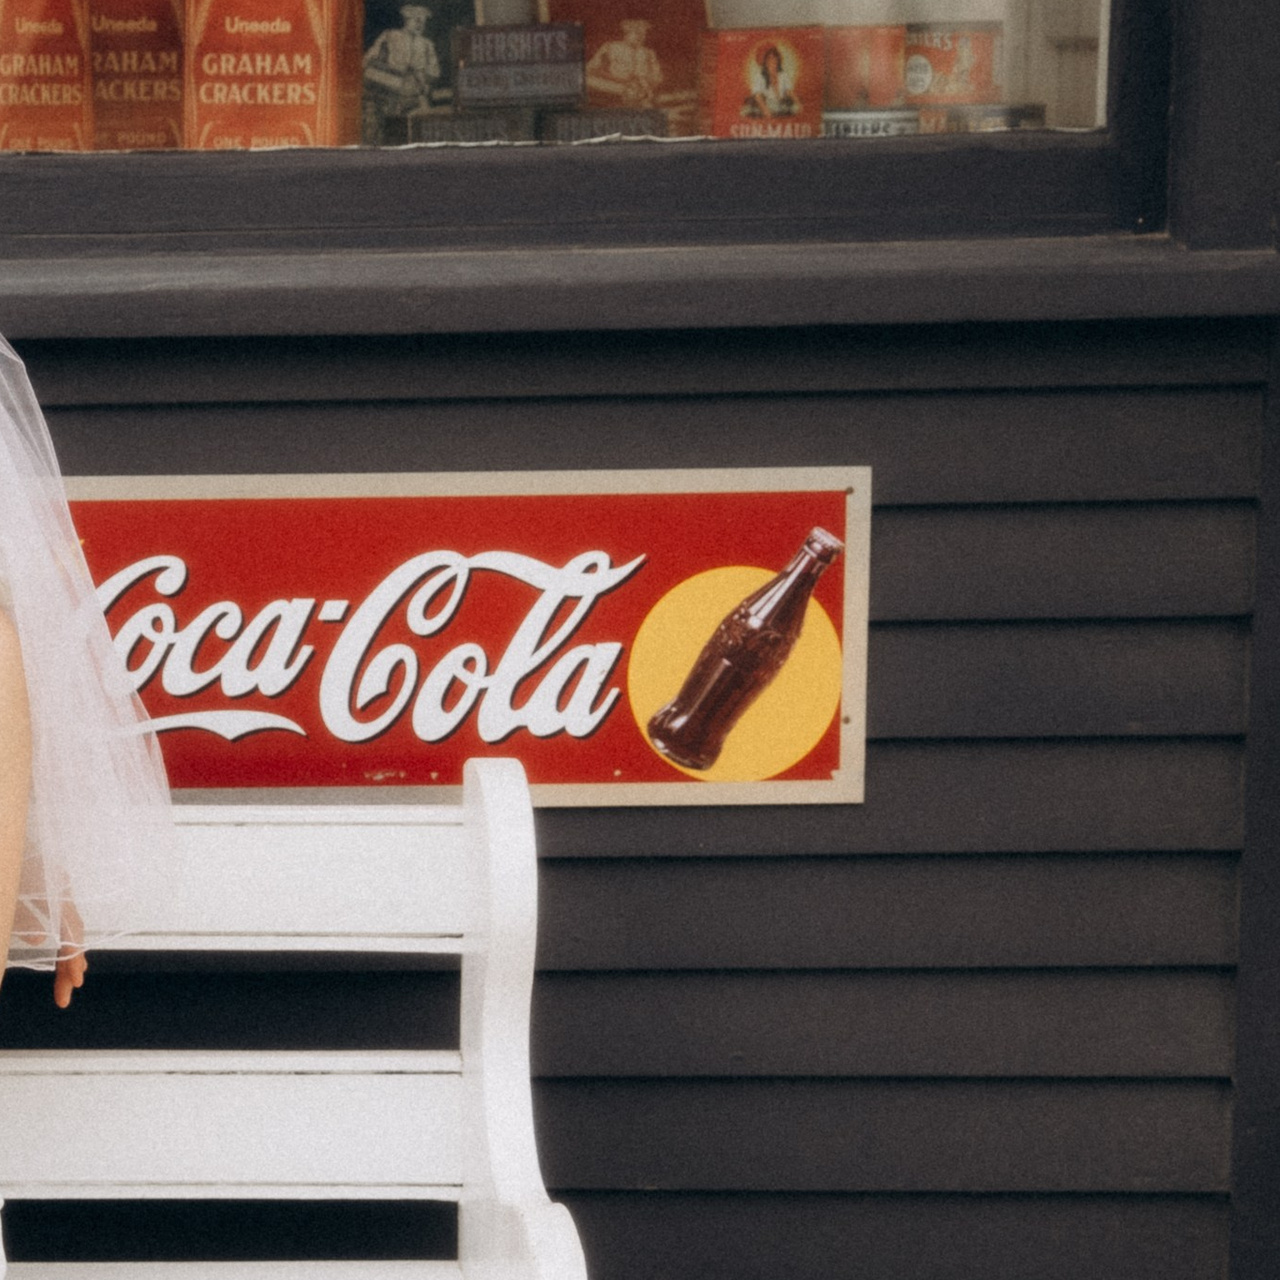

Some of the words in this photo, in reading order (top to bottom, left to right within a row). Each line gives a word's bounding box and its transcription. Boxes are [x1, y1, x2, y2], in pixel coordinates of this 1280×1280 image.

[14, 16, 65, 35] Uneeda
[92, 15, 158, 34] Uneeda
[224, 16, 292, 35] Uneeda
[91, 51, 178, 73] RAHAM
[201, 53, 313, 76] GRAHAM
[95, 79, 183, 102] ACKERS
[199, 82, 317, 106] CRACKERS
